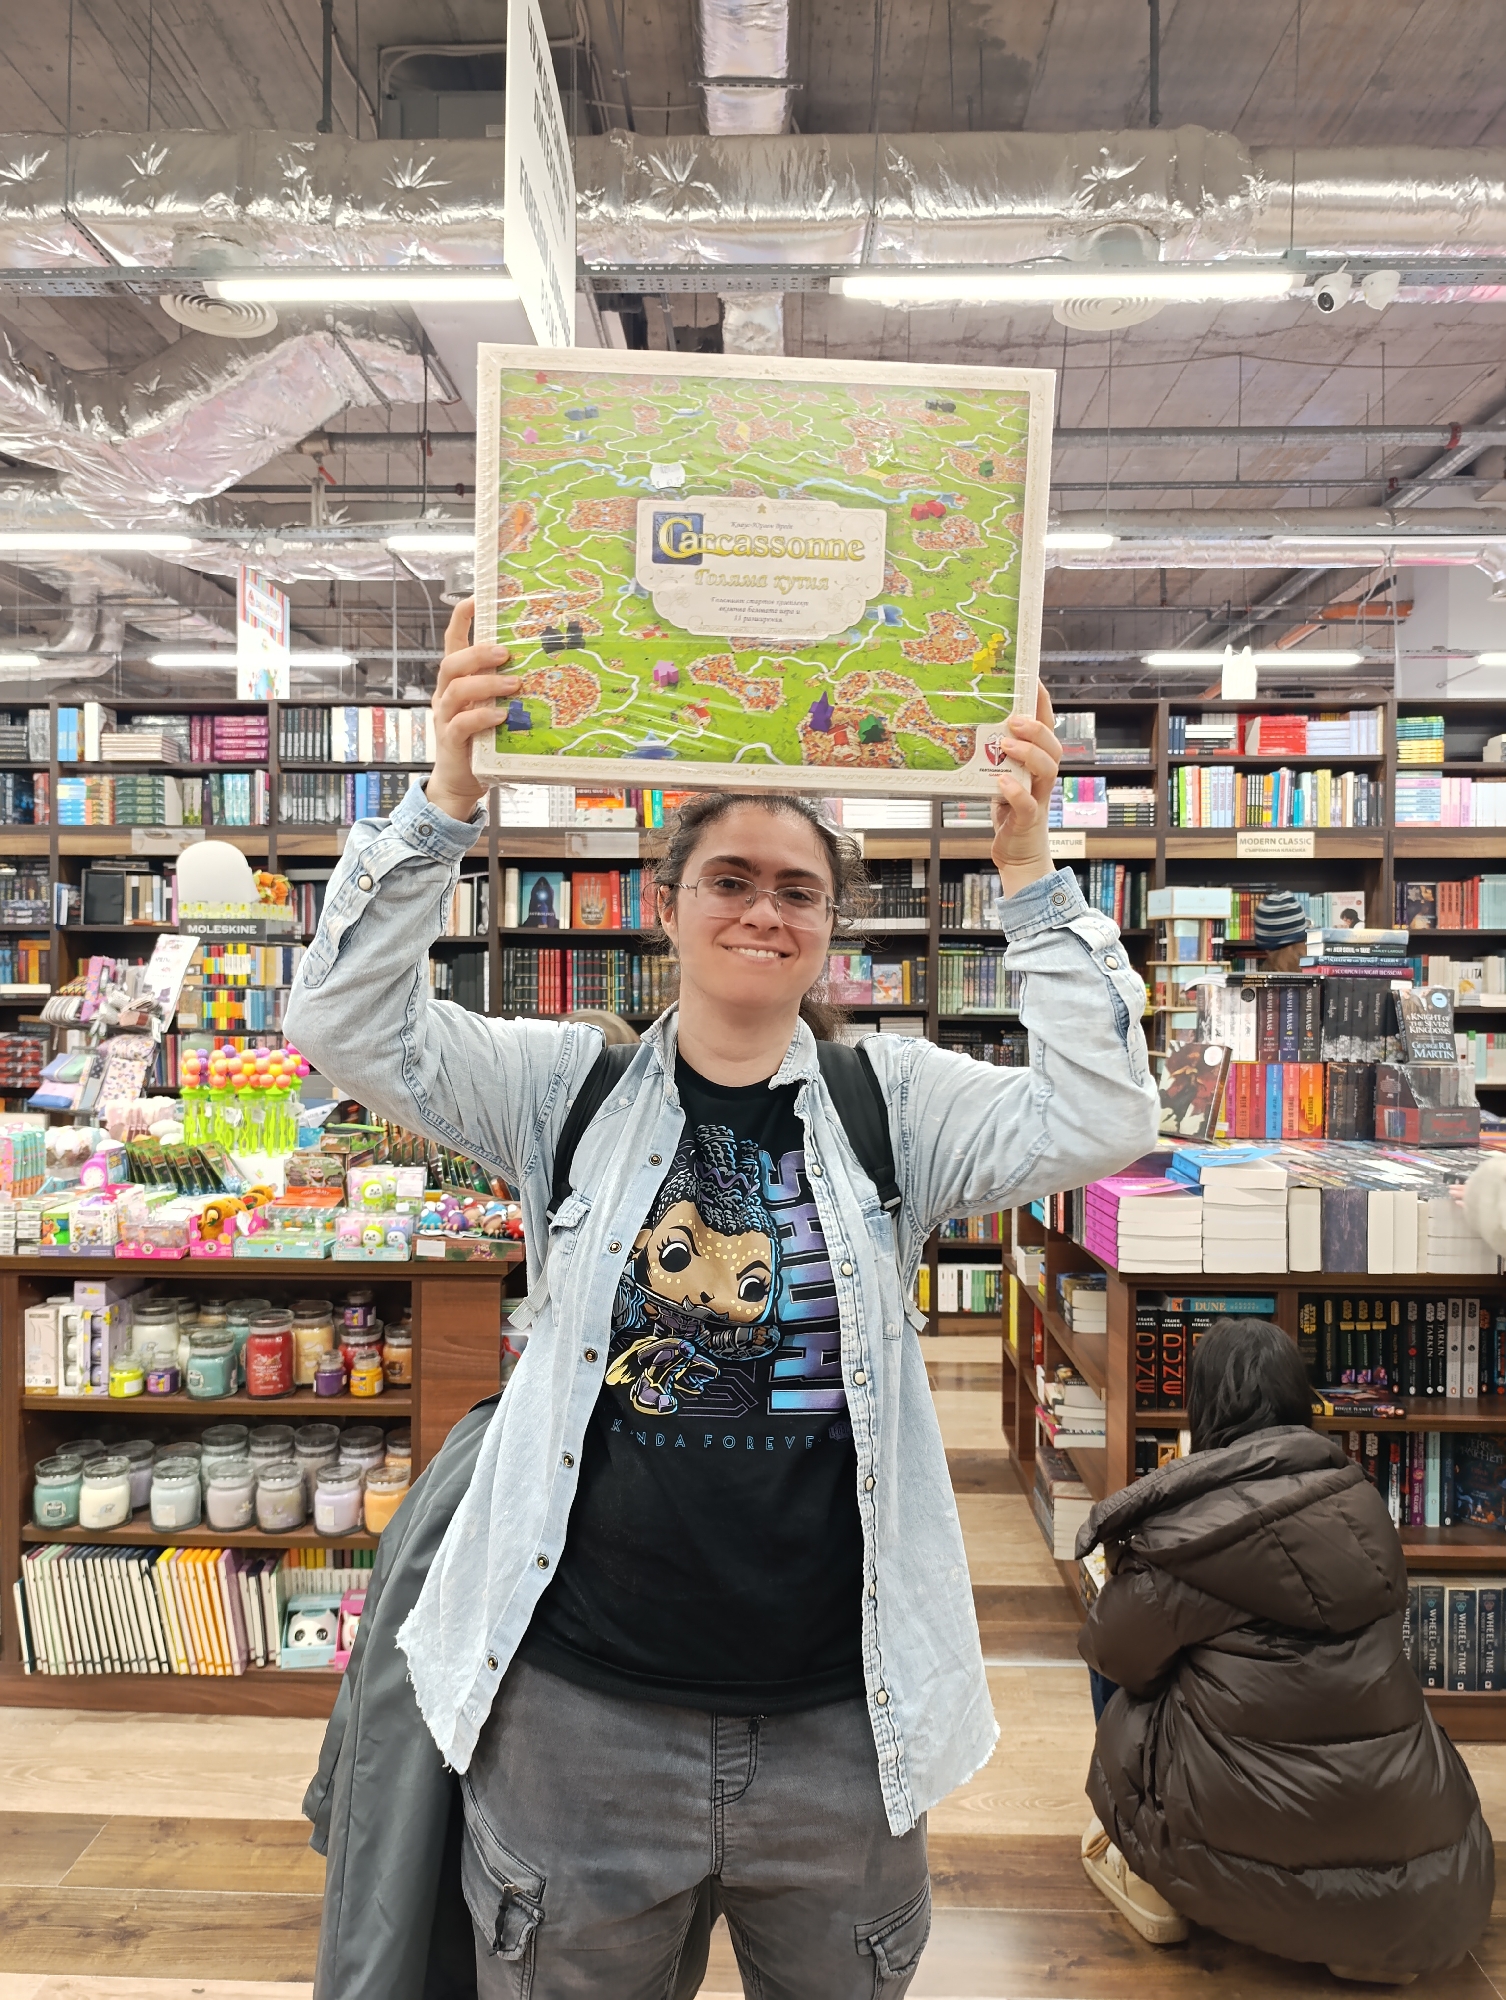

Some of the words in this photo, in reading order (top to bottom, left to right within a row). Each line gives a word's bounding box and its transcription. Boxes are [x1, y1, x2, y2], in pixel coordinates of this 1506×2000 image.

[520, 156, 549, 273] FOREIGN
[658, 517, 866, 562] Carcassonne
[694, 568, 768, 588] Голяма
[773, 573, 830, 595] кутия
[1240, 838, 1277, 846] MODERN
[1278, 838, 1312, 846] CLASSIC
[187, 925, 257, 934] MOLESKINE
[1410, 1012, 1441, 1021] KNIGHT
[1409, 1026, 1452, 1035] KINGDOMS
[1412, 1042, 1439, 1050] GEORGE
[1414, 1049, 1455, 1059] MARTIN
[1194, 1301, 1226, 1311] DUNE
[1136, 1332, 1156, 1393] DUNE
[1162, 1333, 1182, 1395] DUNE
[611, 1418, 686, 1447] KNDA
[703, 1434, 815, 1450] FOREVE
[1429, 1608, 1437, 1641] WHEEL
[1458, 1613, 1466, 1645] WHEEL
[1486, 1612, 1494, 1643] WHEEL
[1429, 1648, 1437, 1671] TIME
[1458, 1652, 1466, 1675] TIME
[1486, 1650, 1494, 1674] TIME
